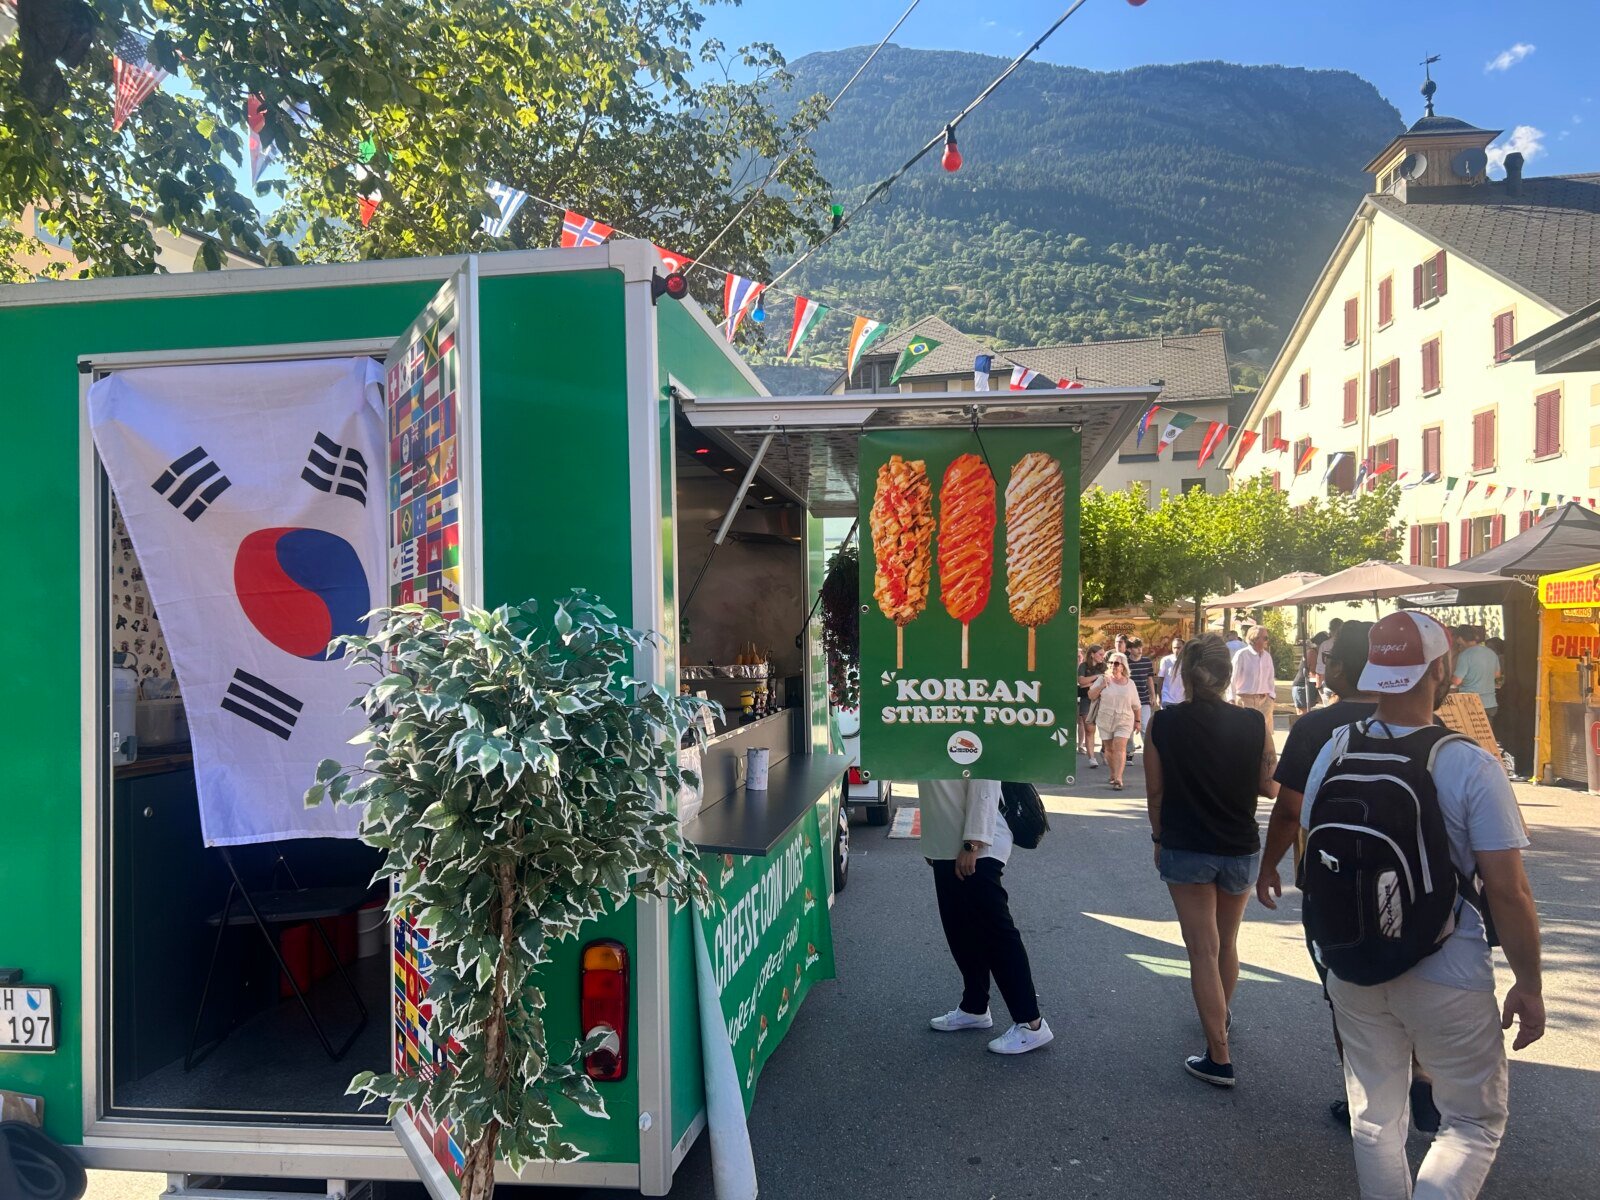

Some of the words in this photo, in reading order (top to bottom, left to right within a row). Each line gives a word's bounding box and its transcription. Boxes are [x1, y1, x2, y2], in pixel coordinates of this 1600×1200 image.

[896, 678, 1042, 703] KOREAN
[1377, 677, 1410, 688] VALAIS
[881, 705, 979, 724] STREET
[983, 706, 1055, 726] FOOD
[715, 883, 759, 998] CHEESE
[8, 1016, 50, 1044] 197
